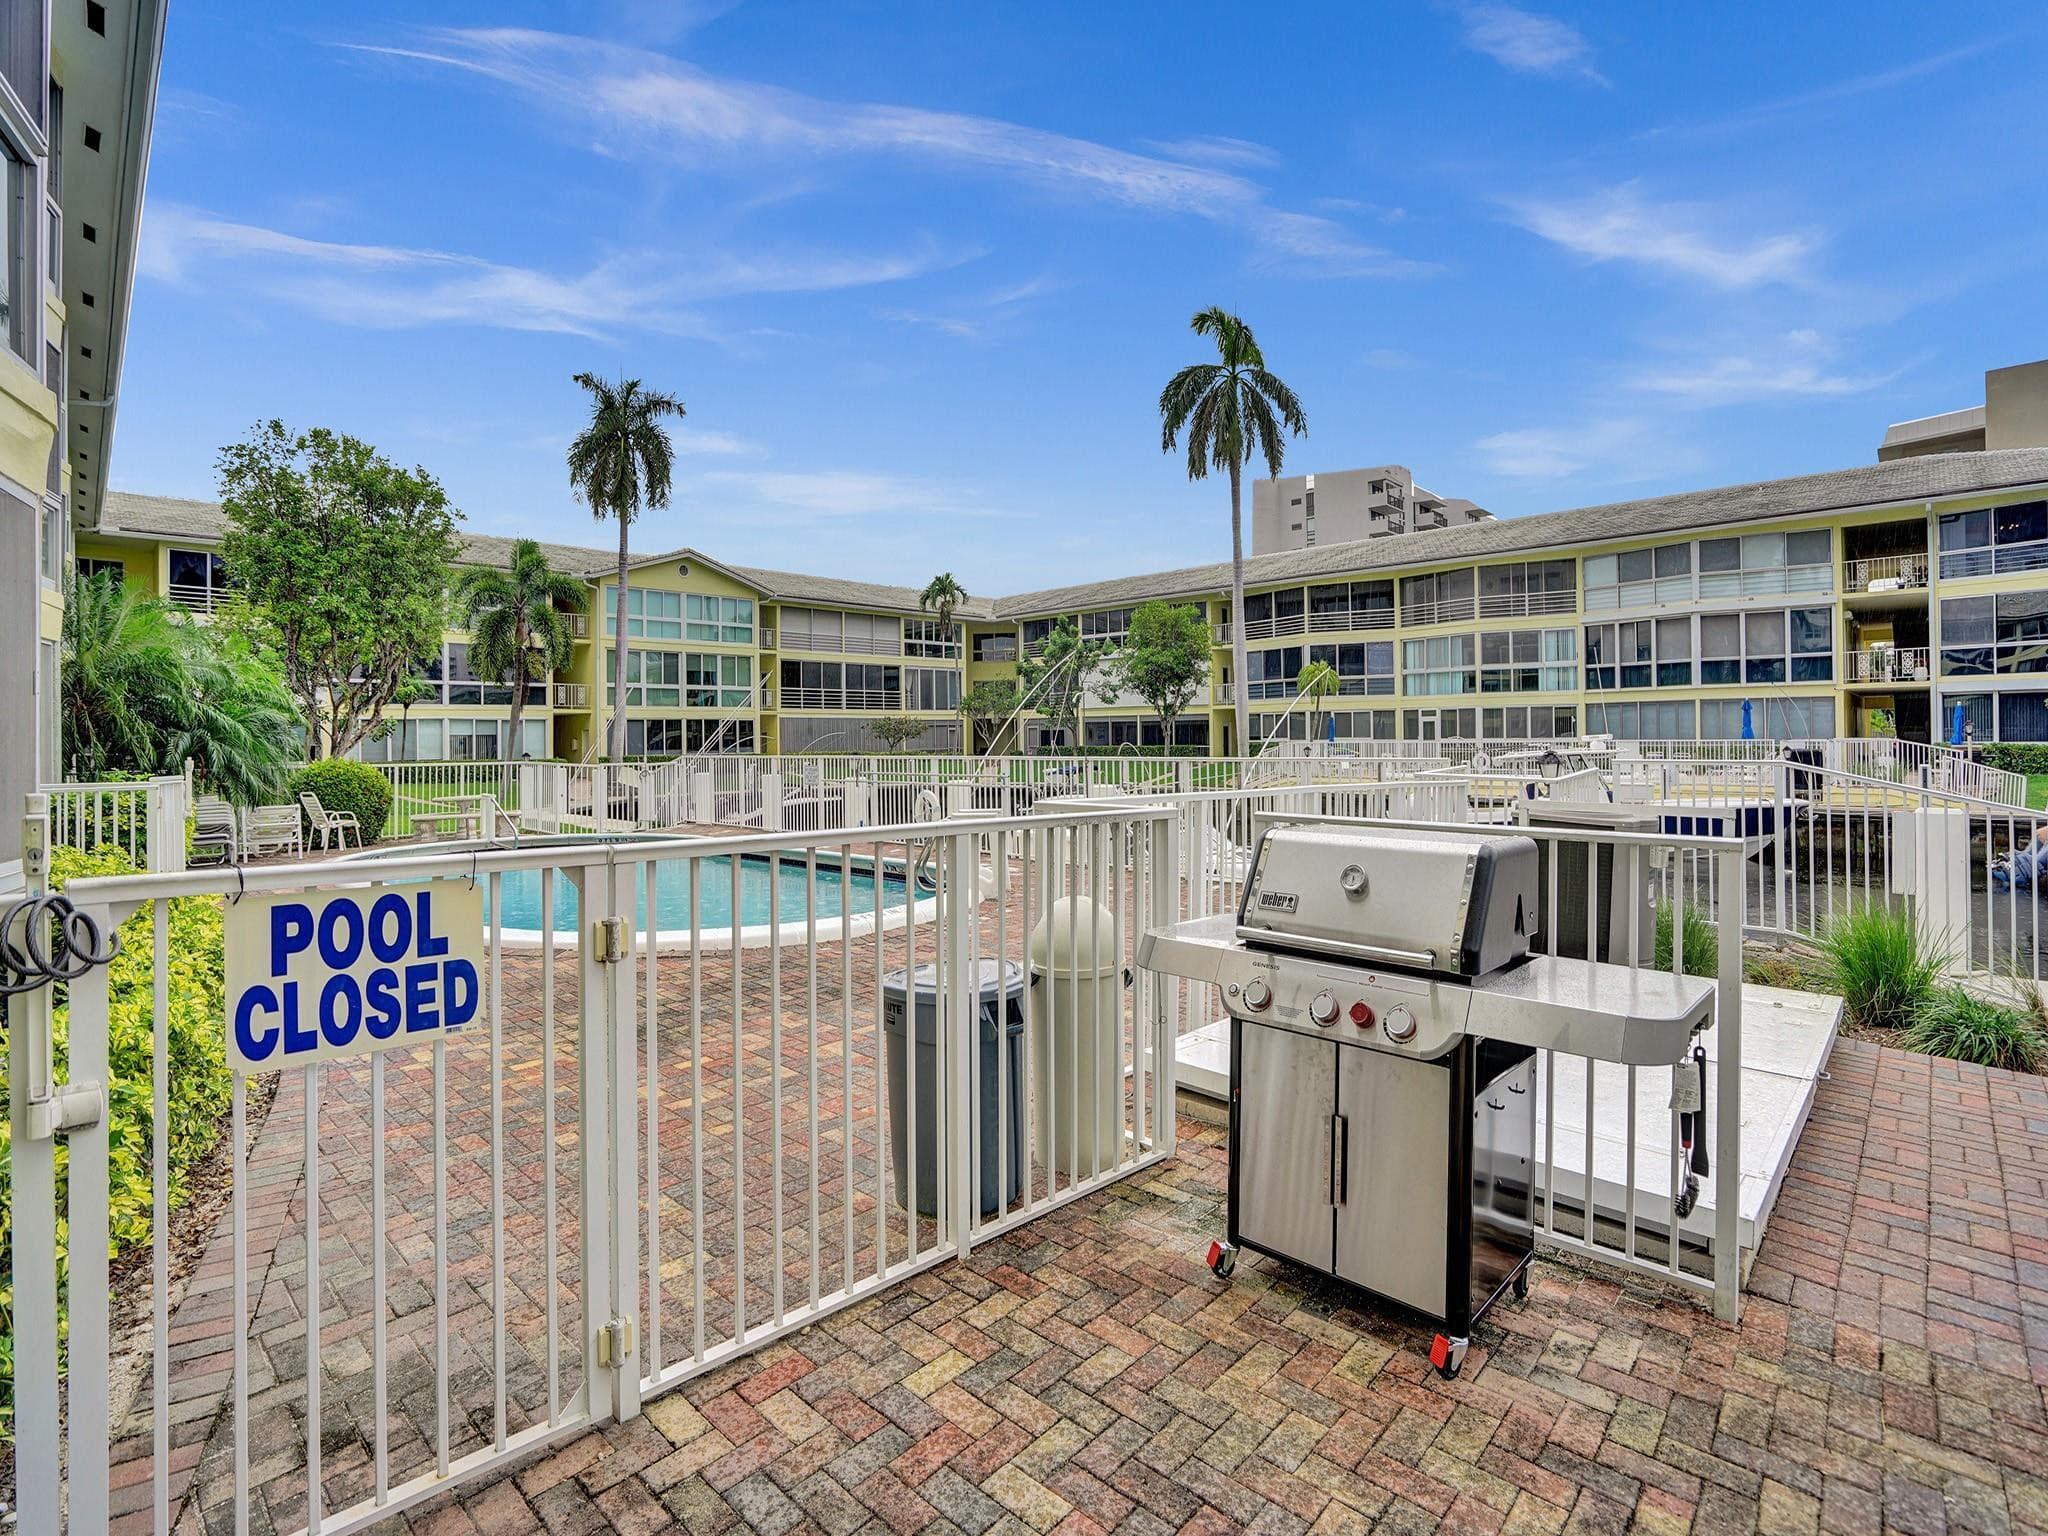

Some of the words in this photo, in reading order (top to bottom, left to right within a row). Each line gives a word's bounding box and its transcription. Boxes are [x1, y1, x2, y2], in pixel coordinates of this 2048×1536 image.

[1261, 892, 1288, 908] weber
[271, 891, 449, 977] POOL
[1252, 961, 1280, 971] GENESIS
[234, 958, 479, 1062] CLOSED
[886, 1002, 903, 1015] UTE
